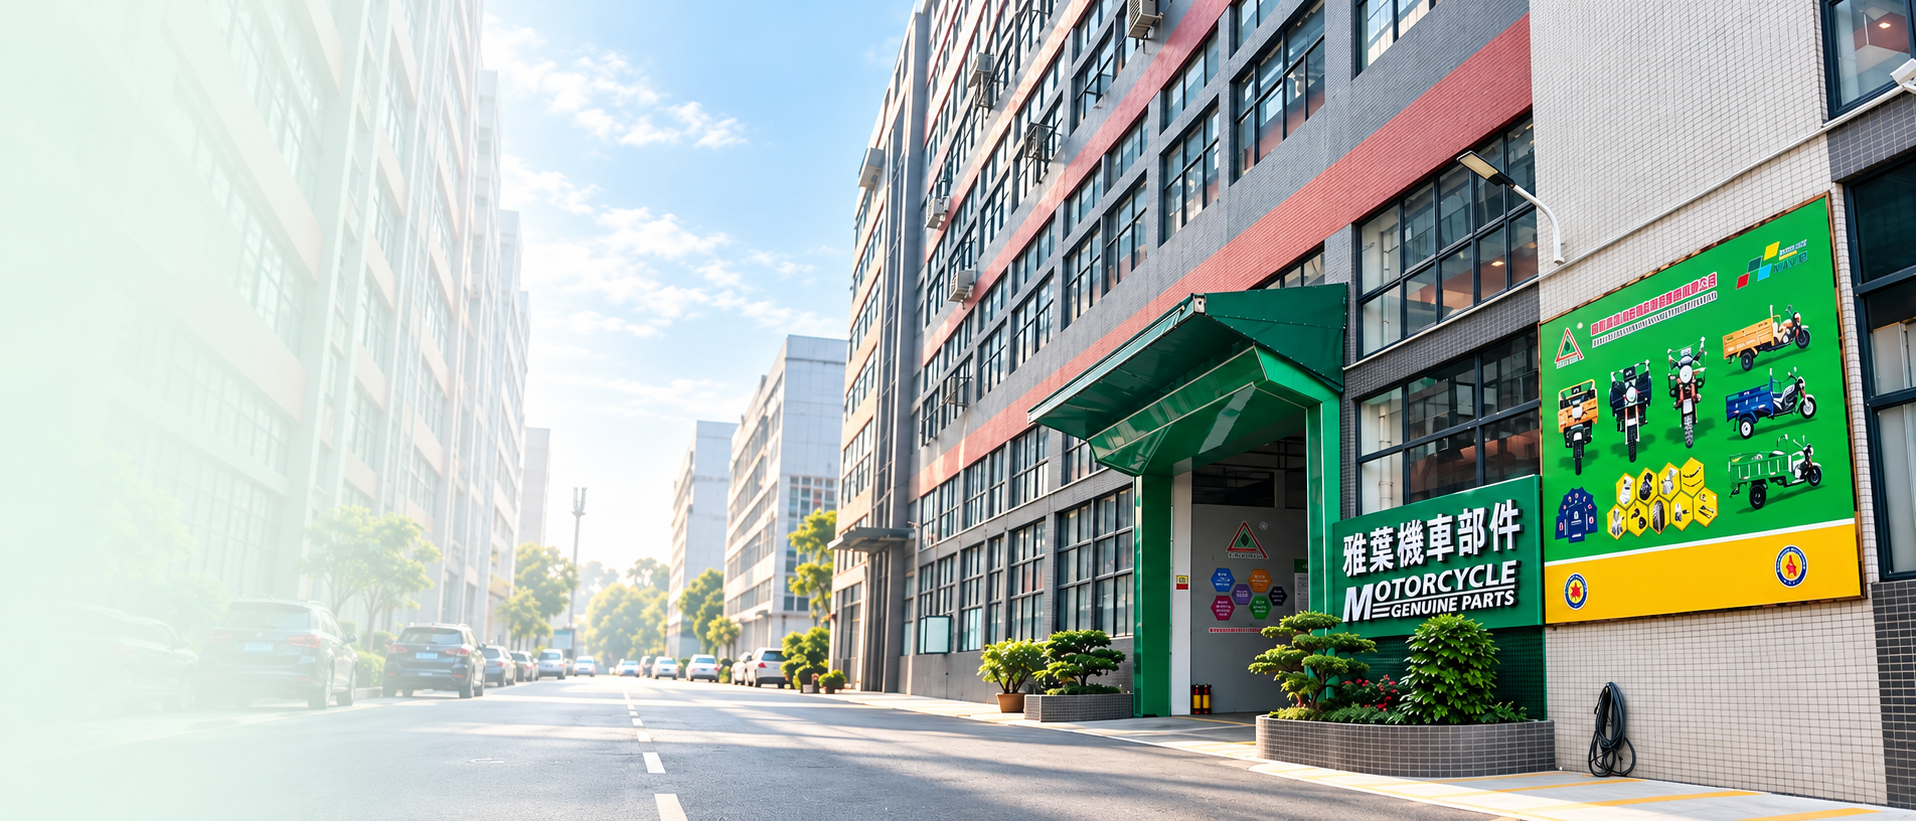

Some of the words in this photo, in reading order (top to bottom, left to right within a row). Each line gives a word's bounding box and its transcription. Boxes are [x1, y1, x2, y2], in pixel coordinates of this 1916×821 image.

[1342, 499, 1521, 577] 雅葉機車部件
[1342, 560, 1517, 622] MOTORCYCLE
[1391, 596, 1458, 618] GENUINE
[1461, 590, 1515, 611] PARTS
